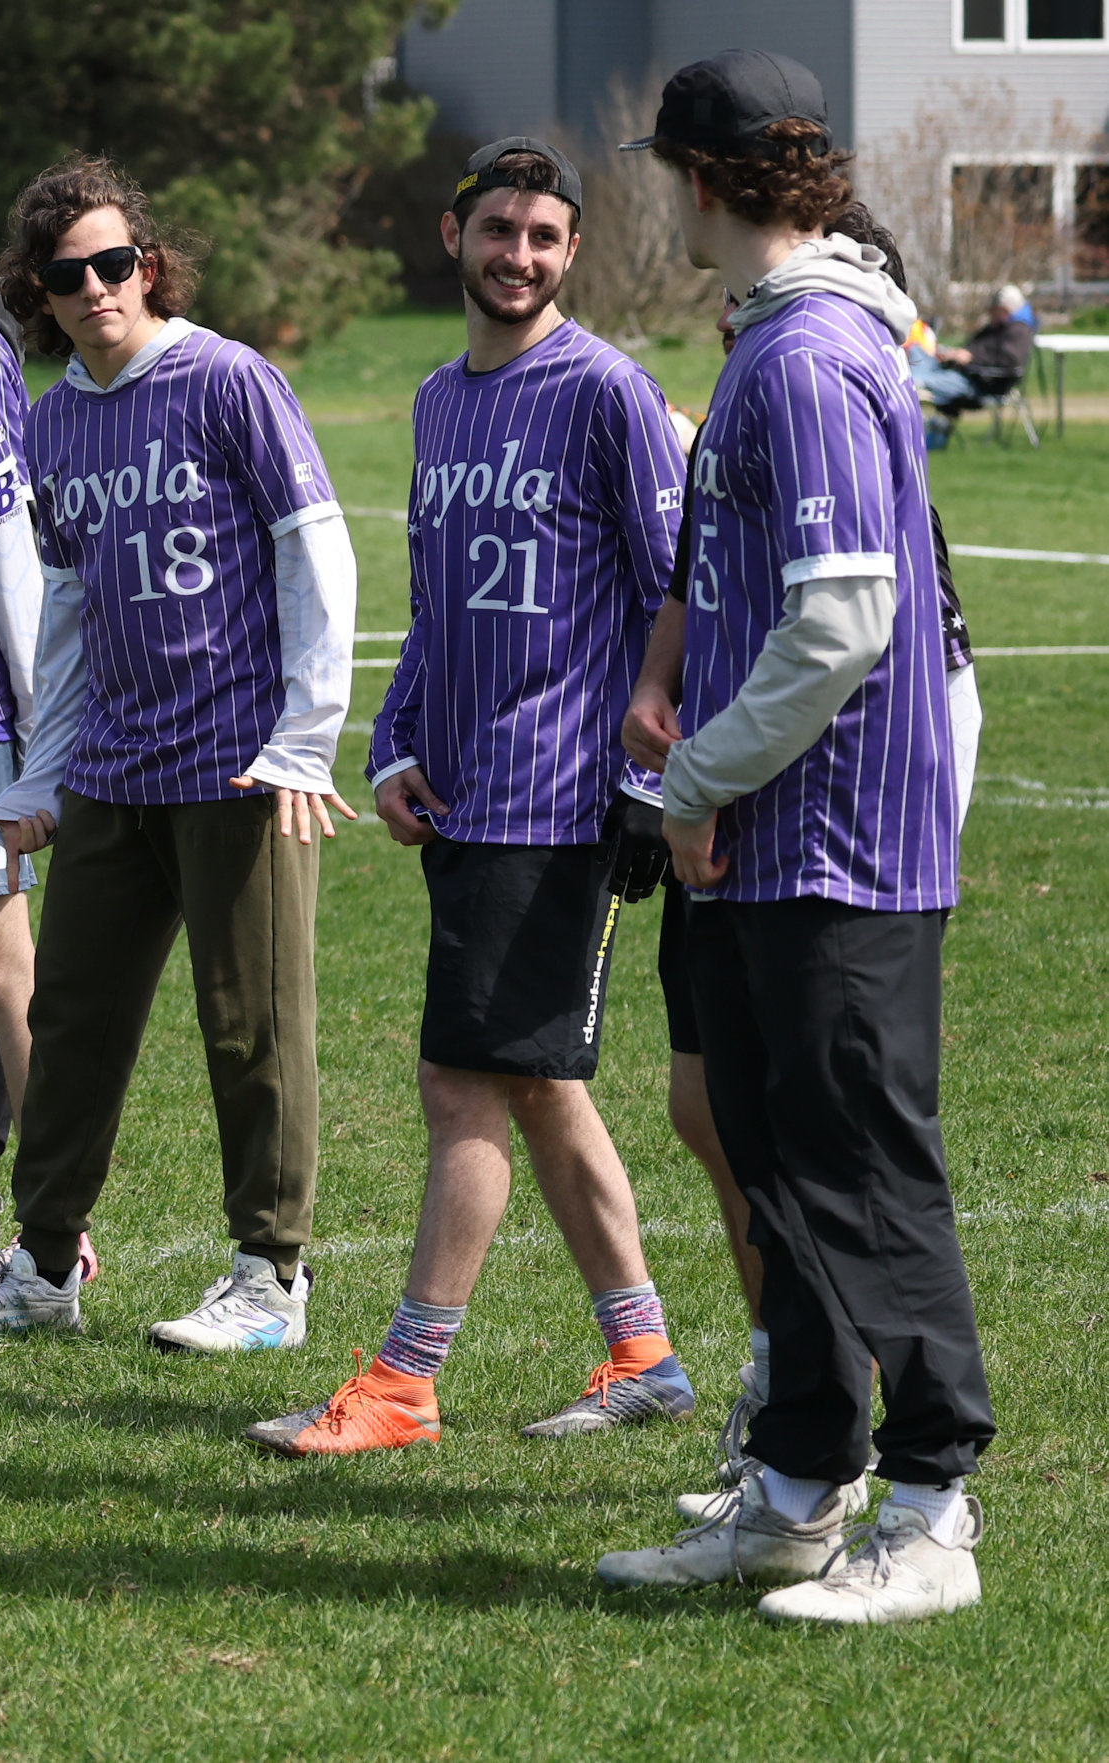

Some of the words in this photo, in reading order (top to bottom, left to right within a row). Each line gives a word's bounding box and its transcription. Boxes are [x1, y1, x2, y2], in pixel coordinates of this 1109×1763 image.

[125, 526, 215, 603] 18
[466, 534, 549, 615] 21
[582, 894, 620, 1045] doublehapp
